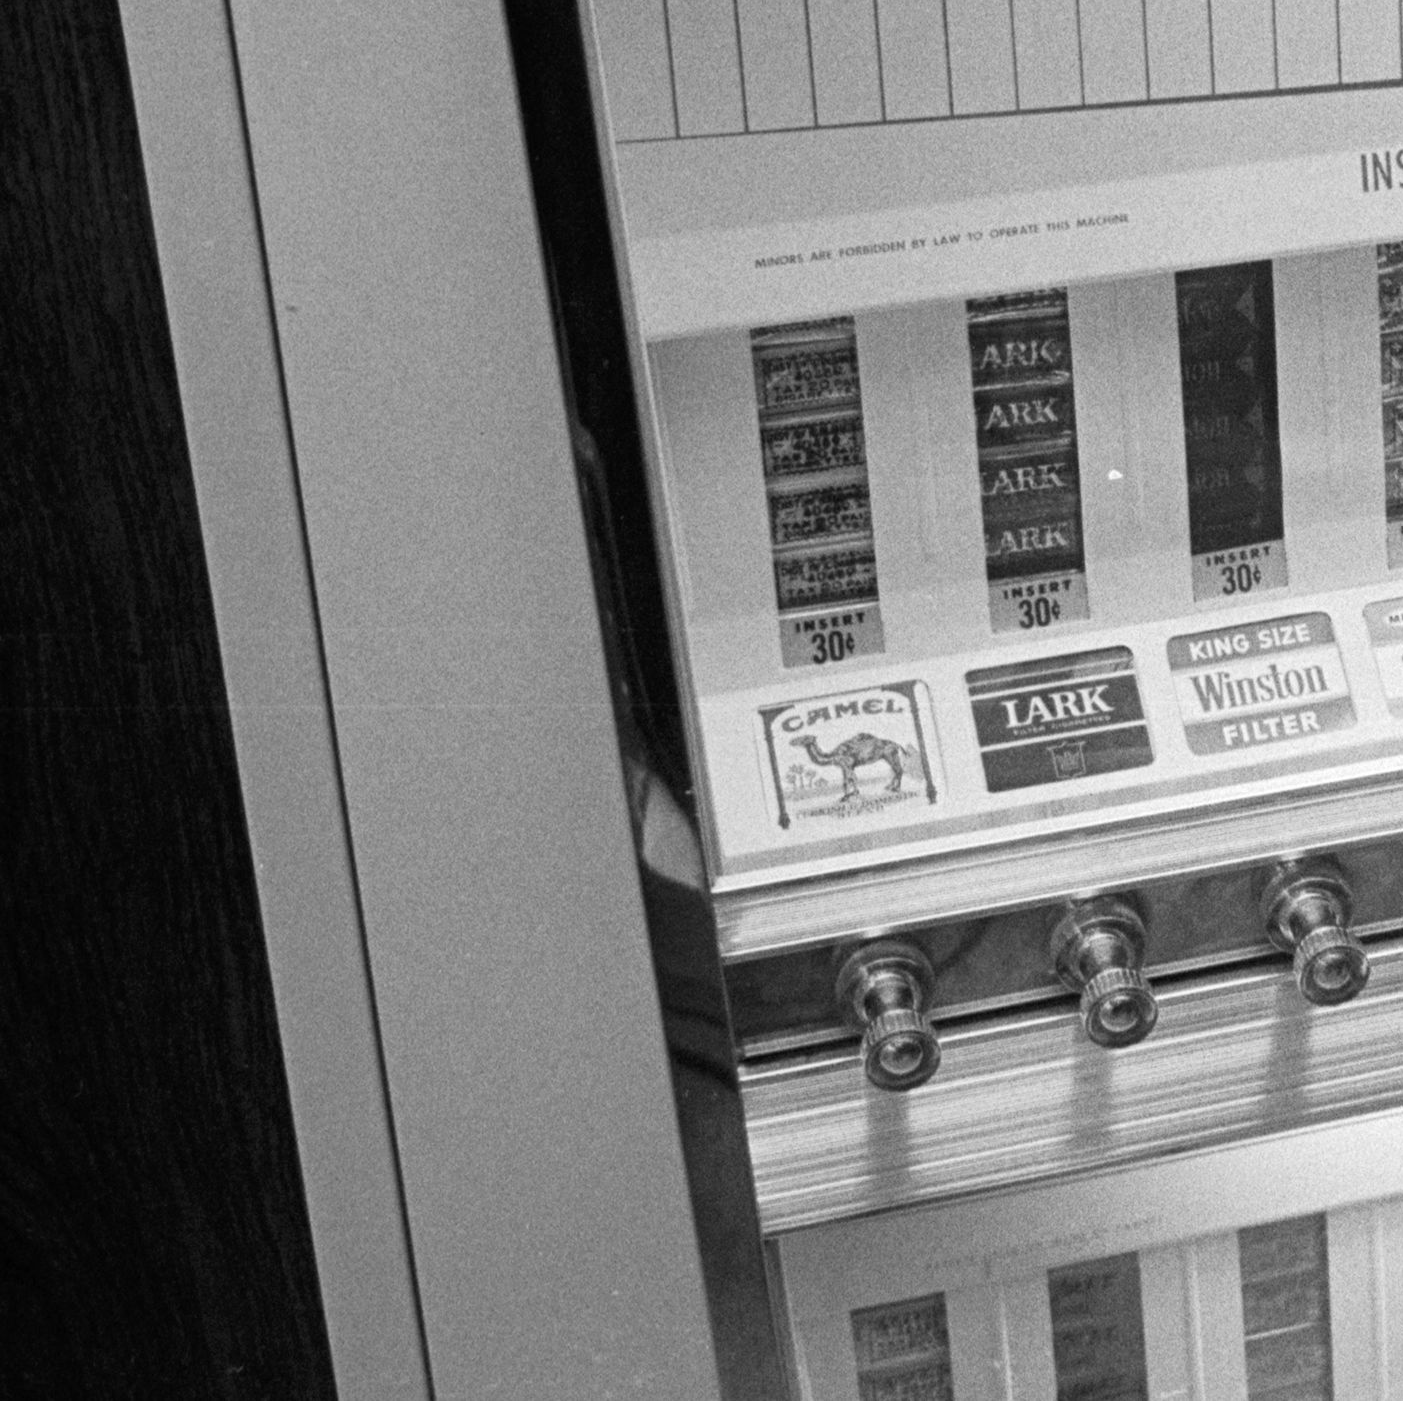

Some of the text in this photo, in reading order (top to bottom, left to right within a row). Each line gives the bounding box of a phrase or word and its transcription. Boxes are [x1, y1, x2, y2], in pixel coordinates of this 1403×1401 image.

[754, 213, 1131, 270] MINORS ARE FORBIDDEN BY LAW TO OPERATE THIS MACHINE
[979, 338, 1062, 373] ARK
[983, 398, 1060, 431] ARK
[985, 522, 1070, 556] ARK
[1205, 545, 1272, 567] INSERT
[1002, 579, 1073, 600] INSERT
[1221, 562, 1262, 596] 30¢
[795, 611, 866, 634] INSERT
[1018, 596, 1061, 630] 30¢
[810, 629, 856, 666] 30¢
[1188, 622, 1312, 662] KING SIZE
[1189, 663, 1329, 714] Winston
[781, 697, 904, 734] CAMEL
[1001, 684, 1116, 729] LARK
[1222, 710, 1322, 746] FILTER
